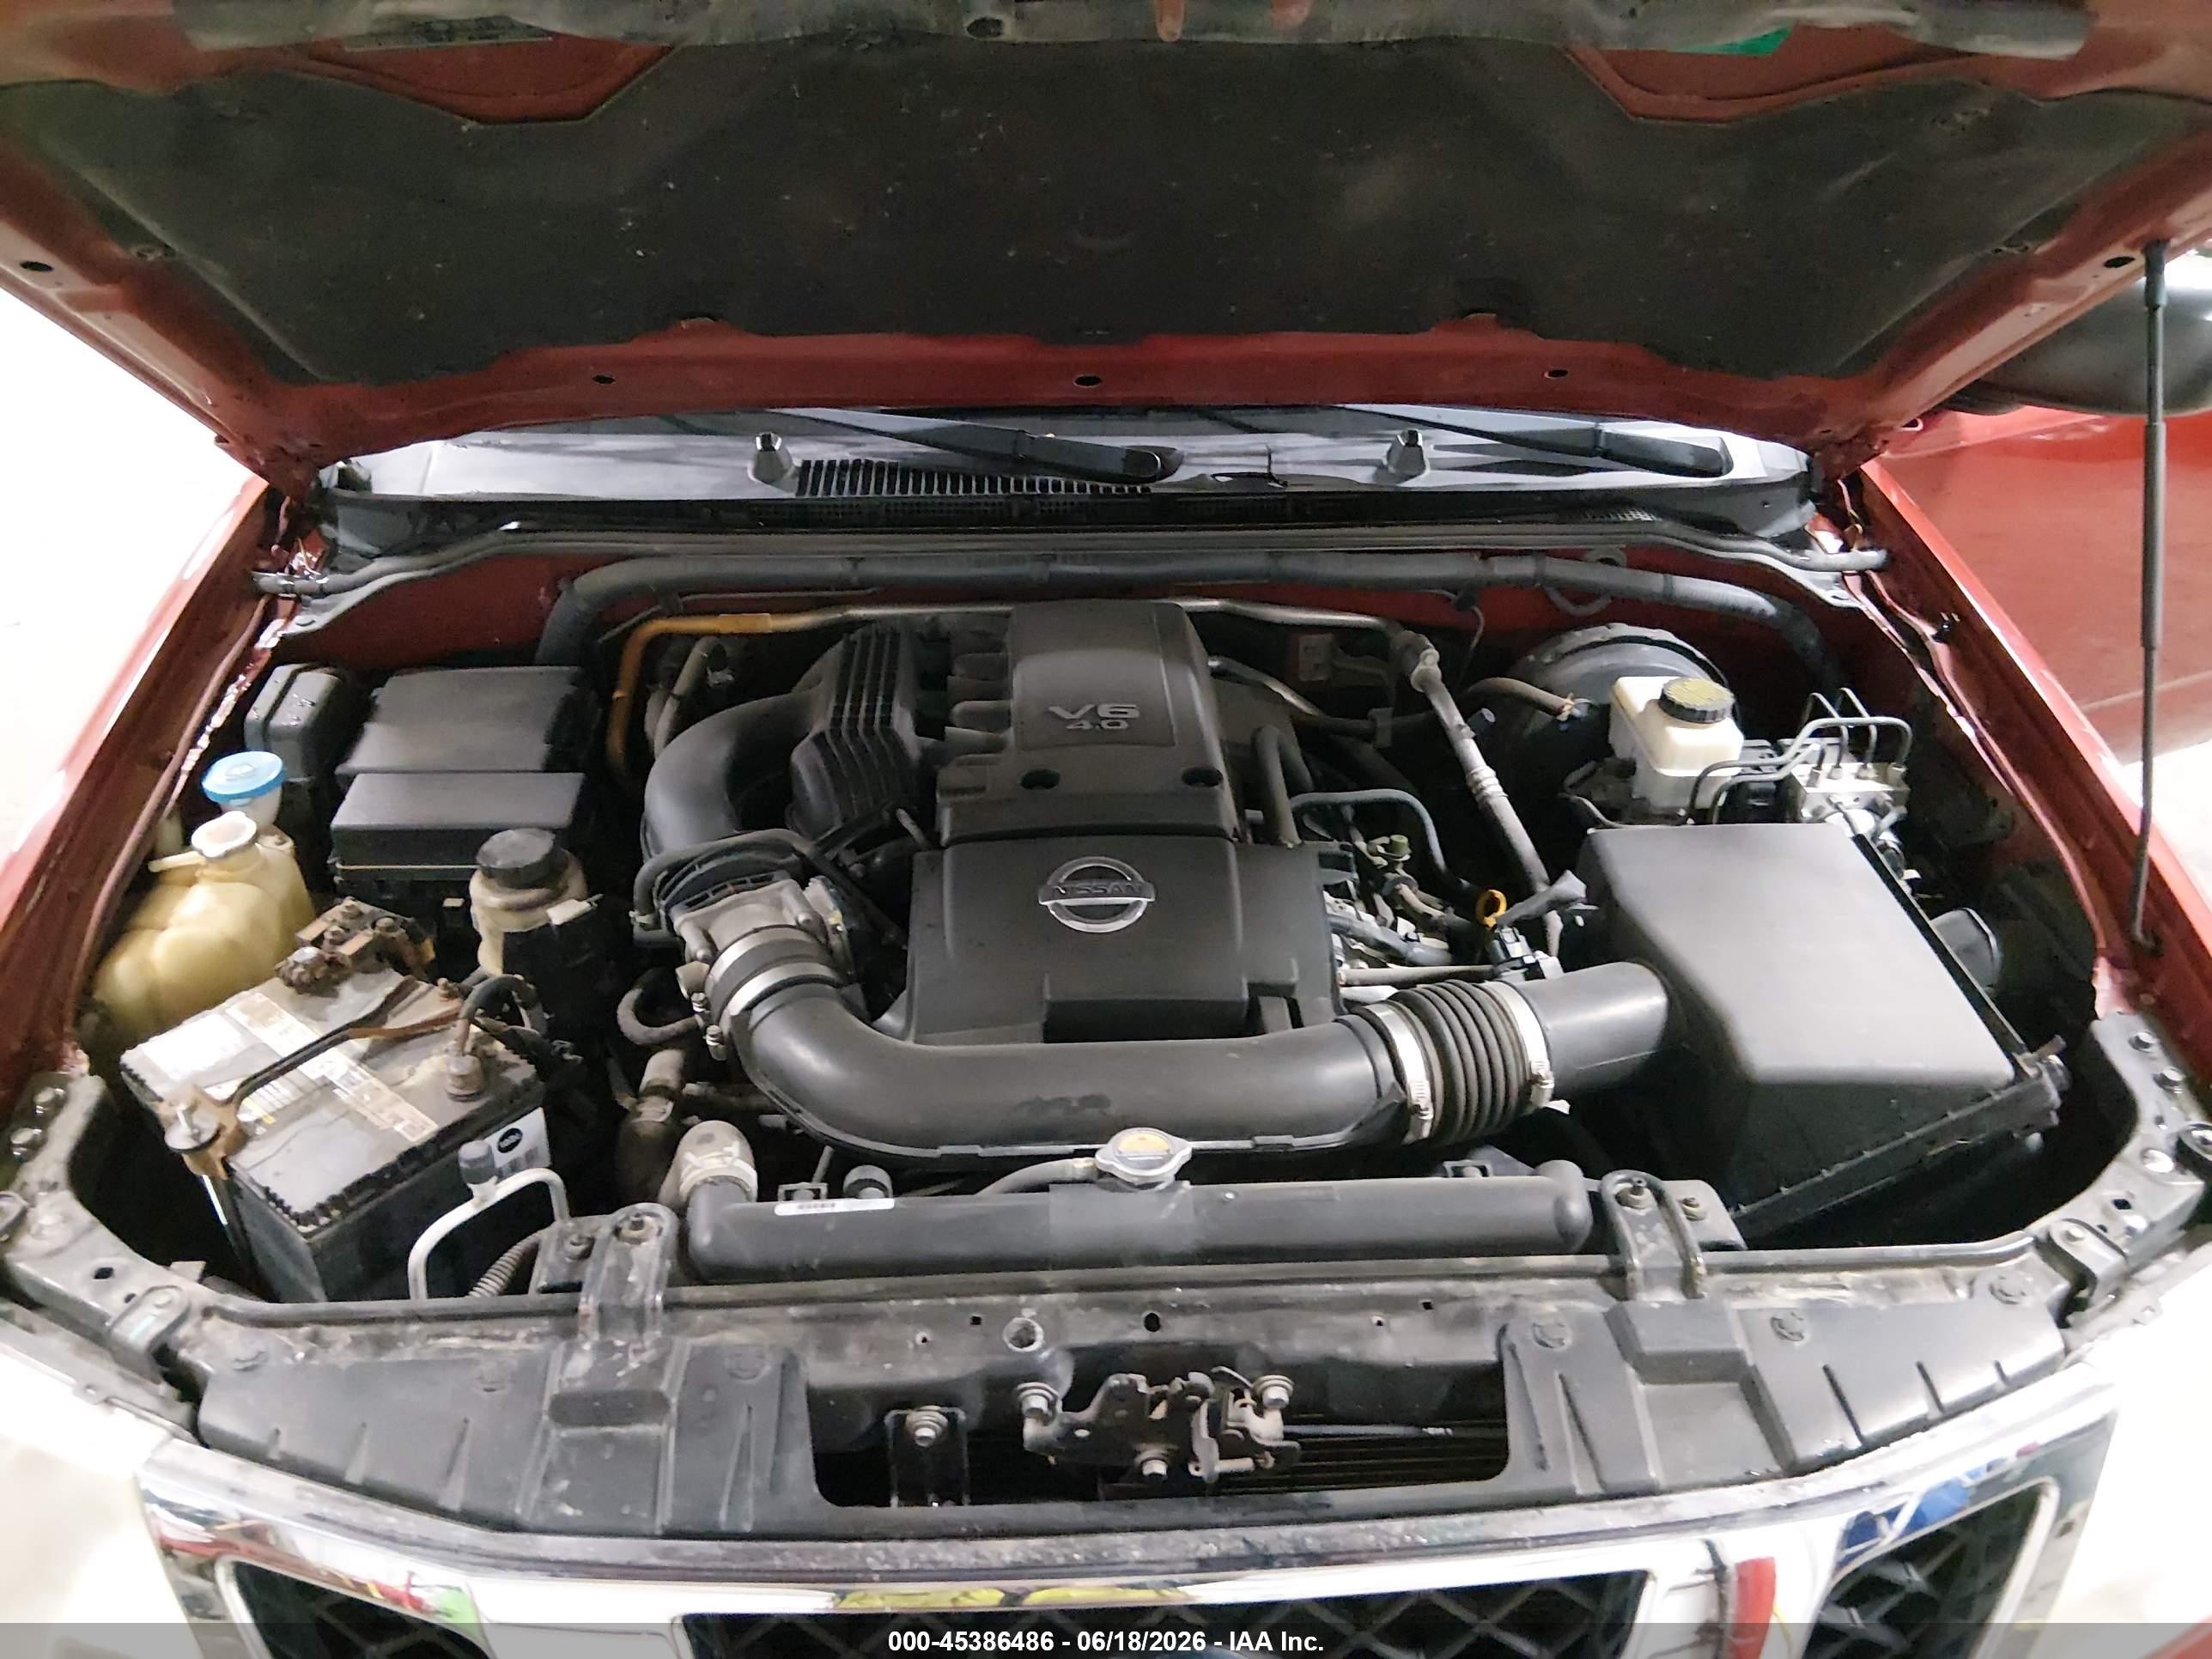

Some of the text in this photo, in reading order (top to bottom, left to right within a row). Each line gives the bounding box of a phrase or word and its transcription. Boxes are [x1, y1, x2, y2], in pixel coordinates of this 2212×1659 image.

[1048, 703, 1140, 720] V6
[1066, 720, 1129, 730] 4.0
[1050, 881, 1142, 896] NISSAN
